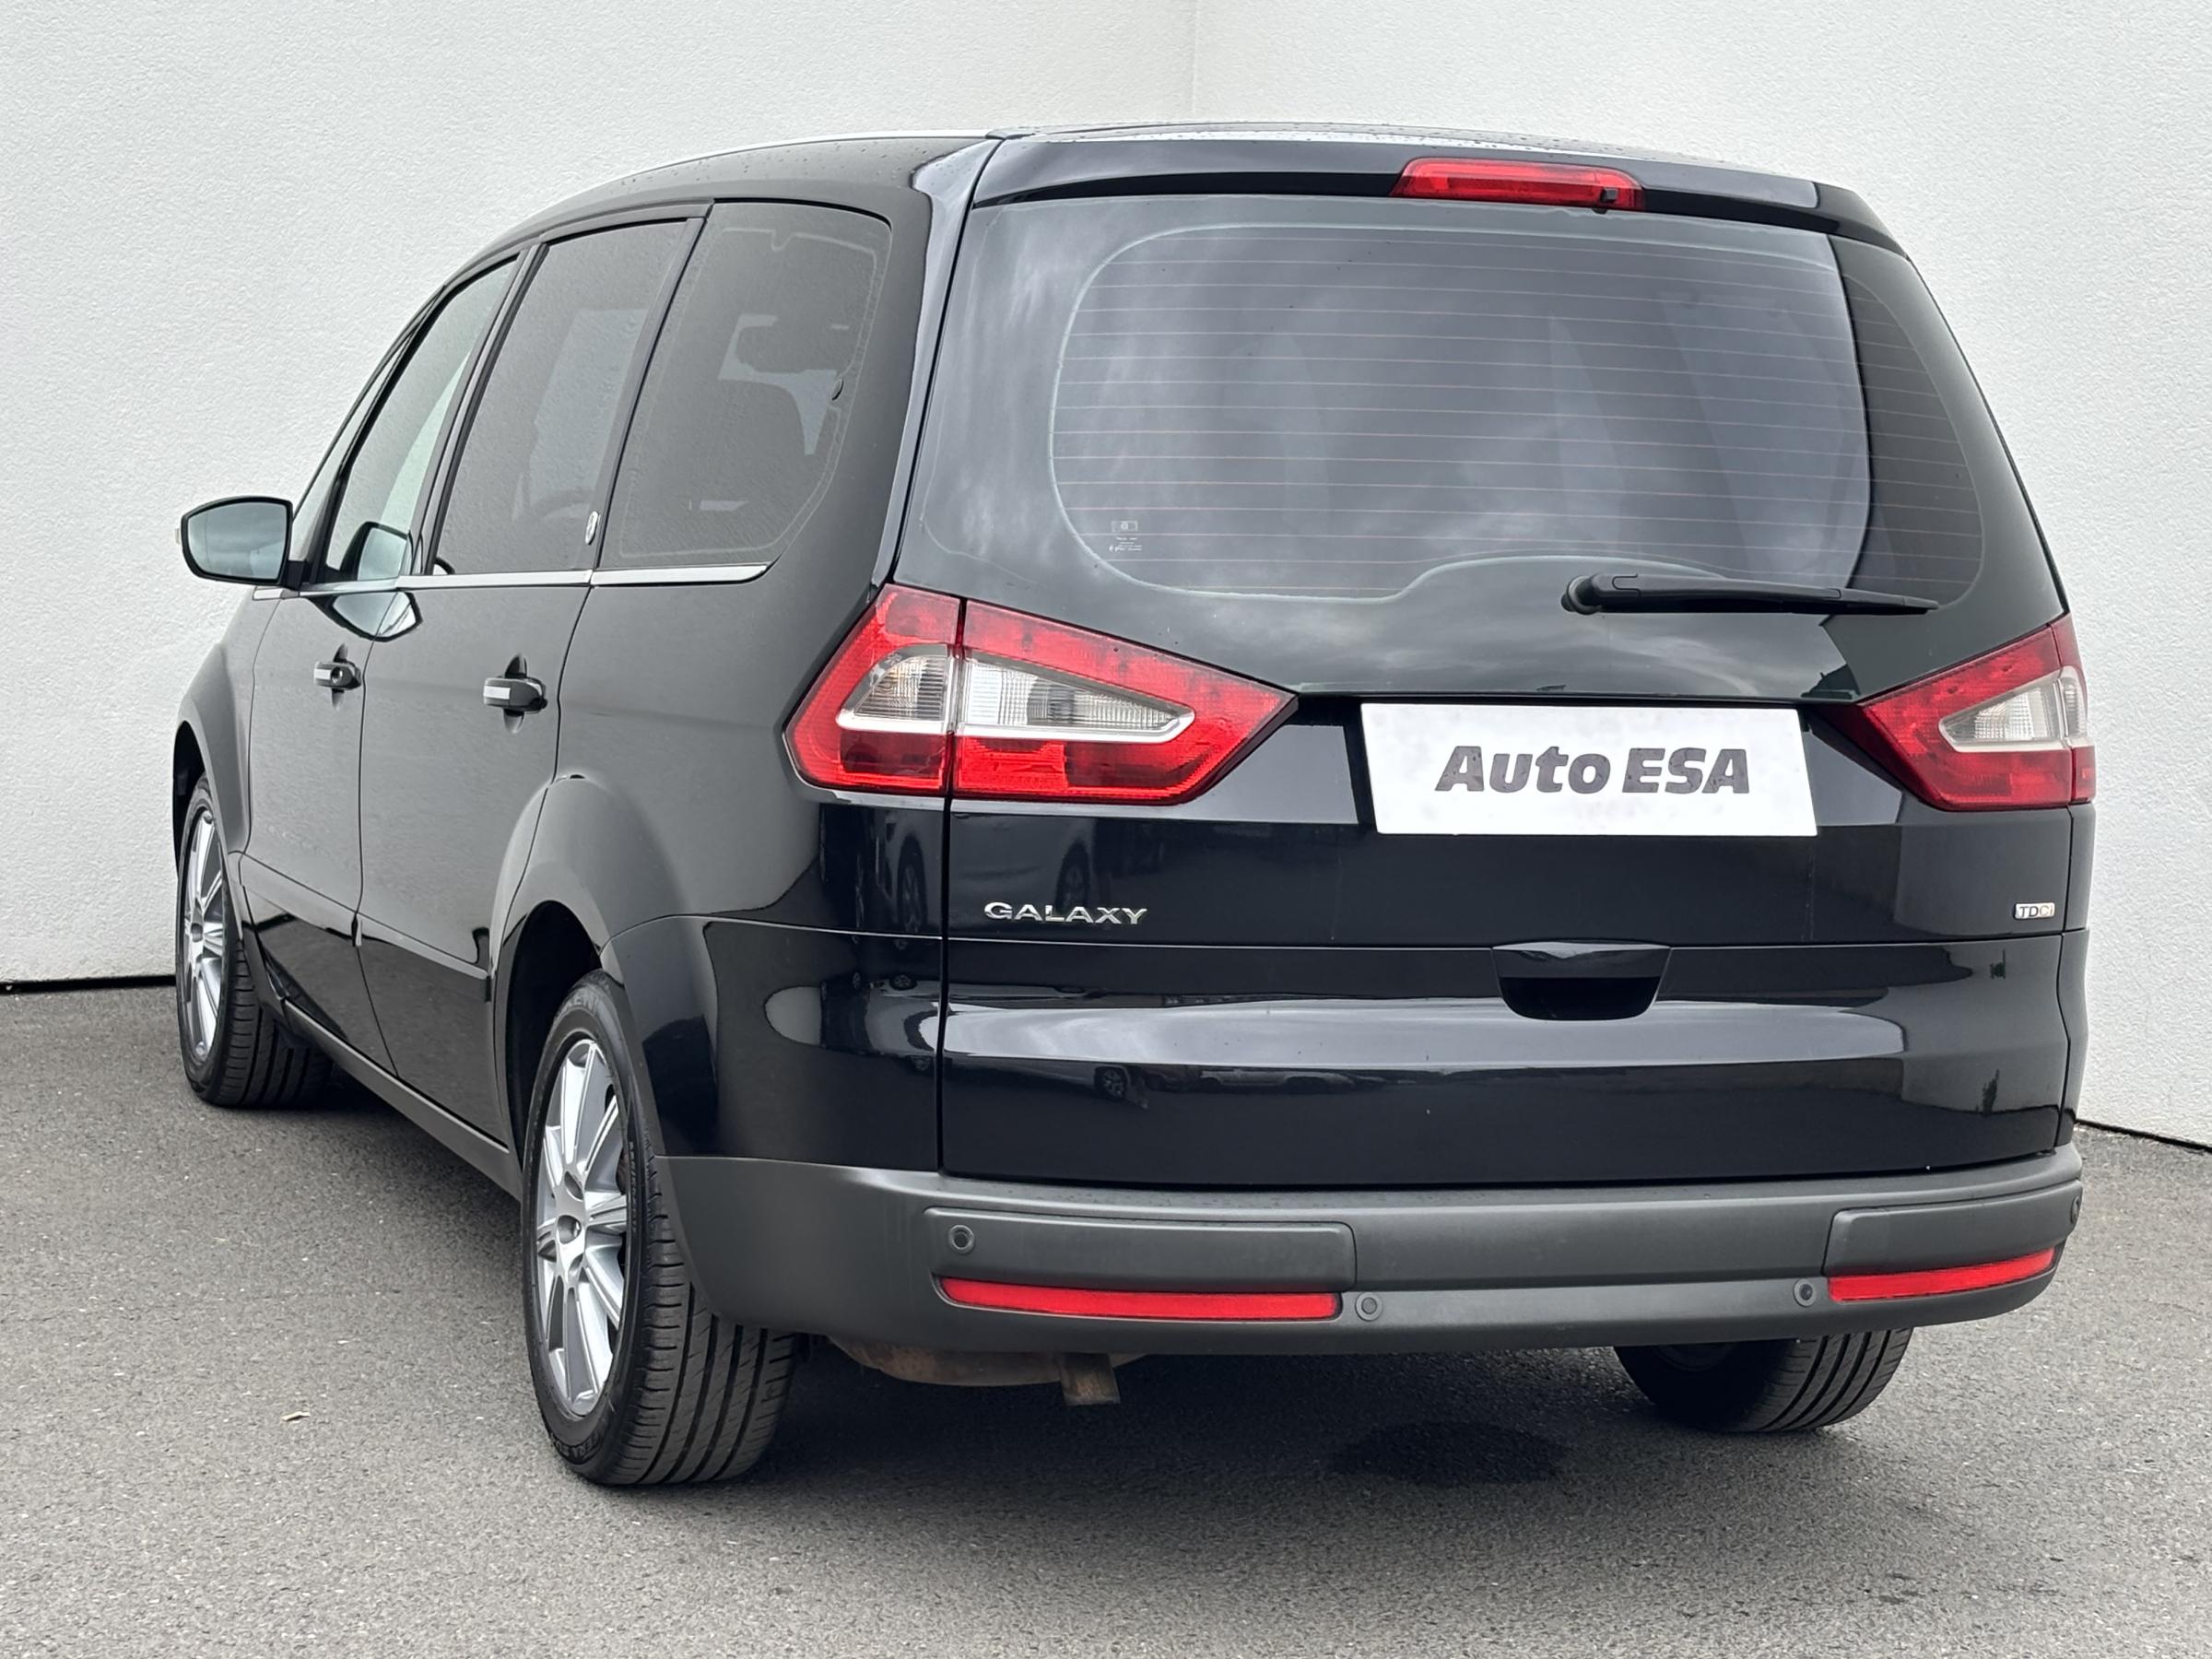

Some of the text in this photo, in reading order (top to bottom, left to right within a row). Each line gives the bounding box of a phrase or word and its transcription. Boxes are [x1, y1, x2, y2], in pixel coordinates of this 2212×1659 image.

[1434, 746, 1749, 794] Auto ESA
[983, 901, 1148, 925] GALAXY
